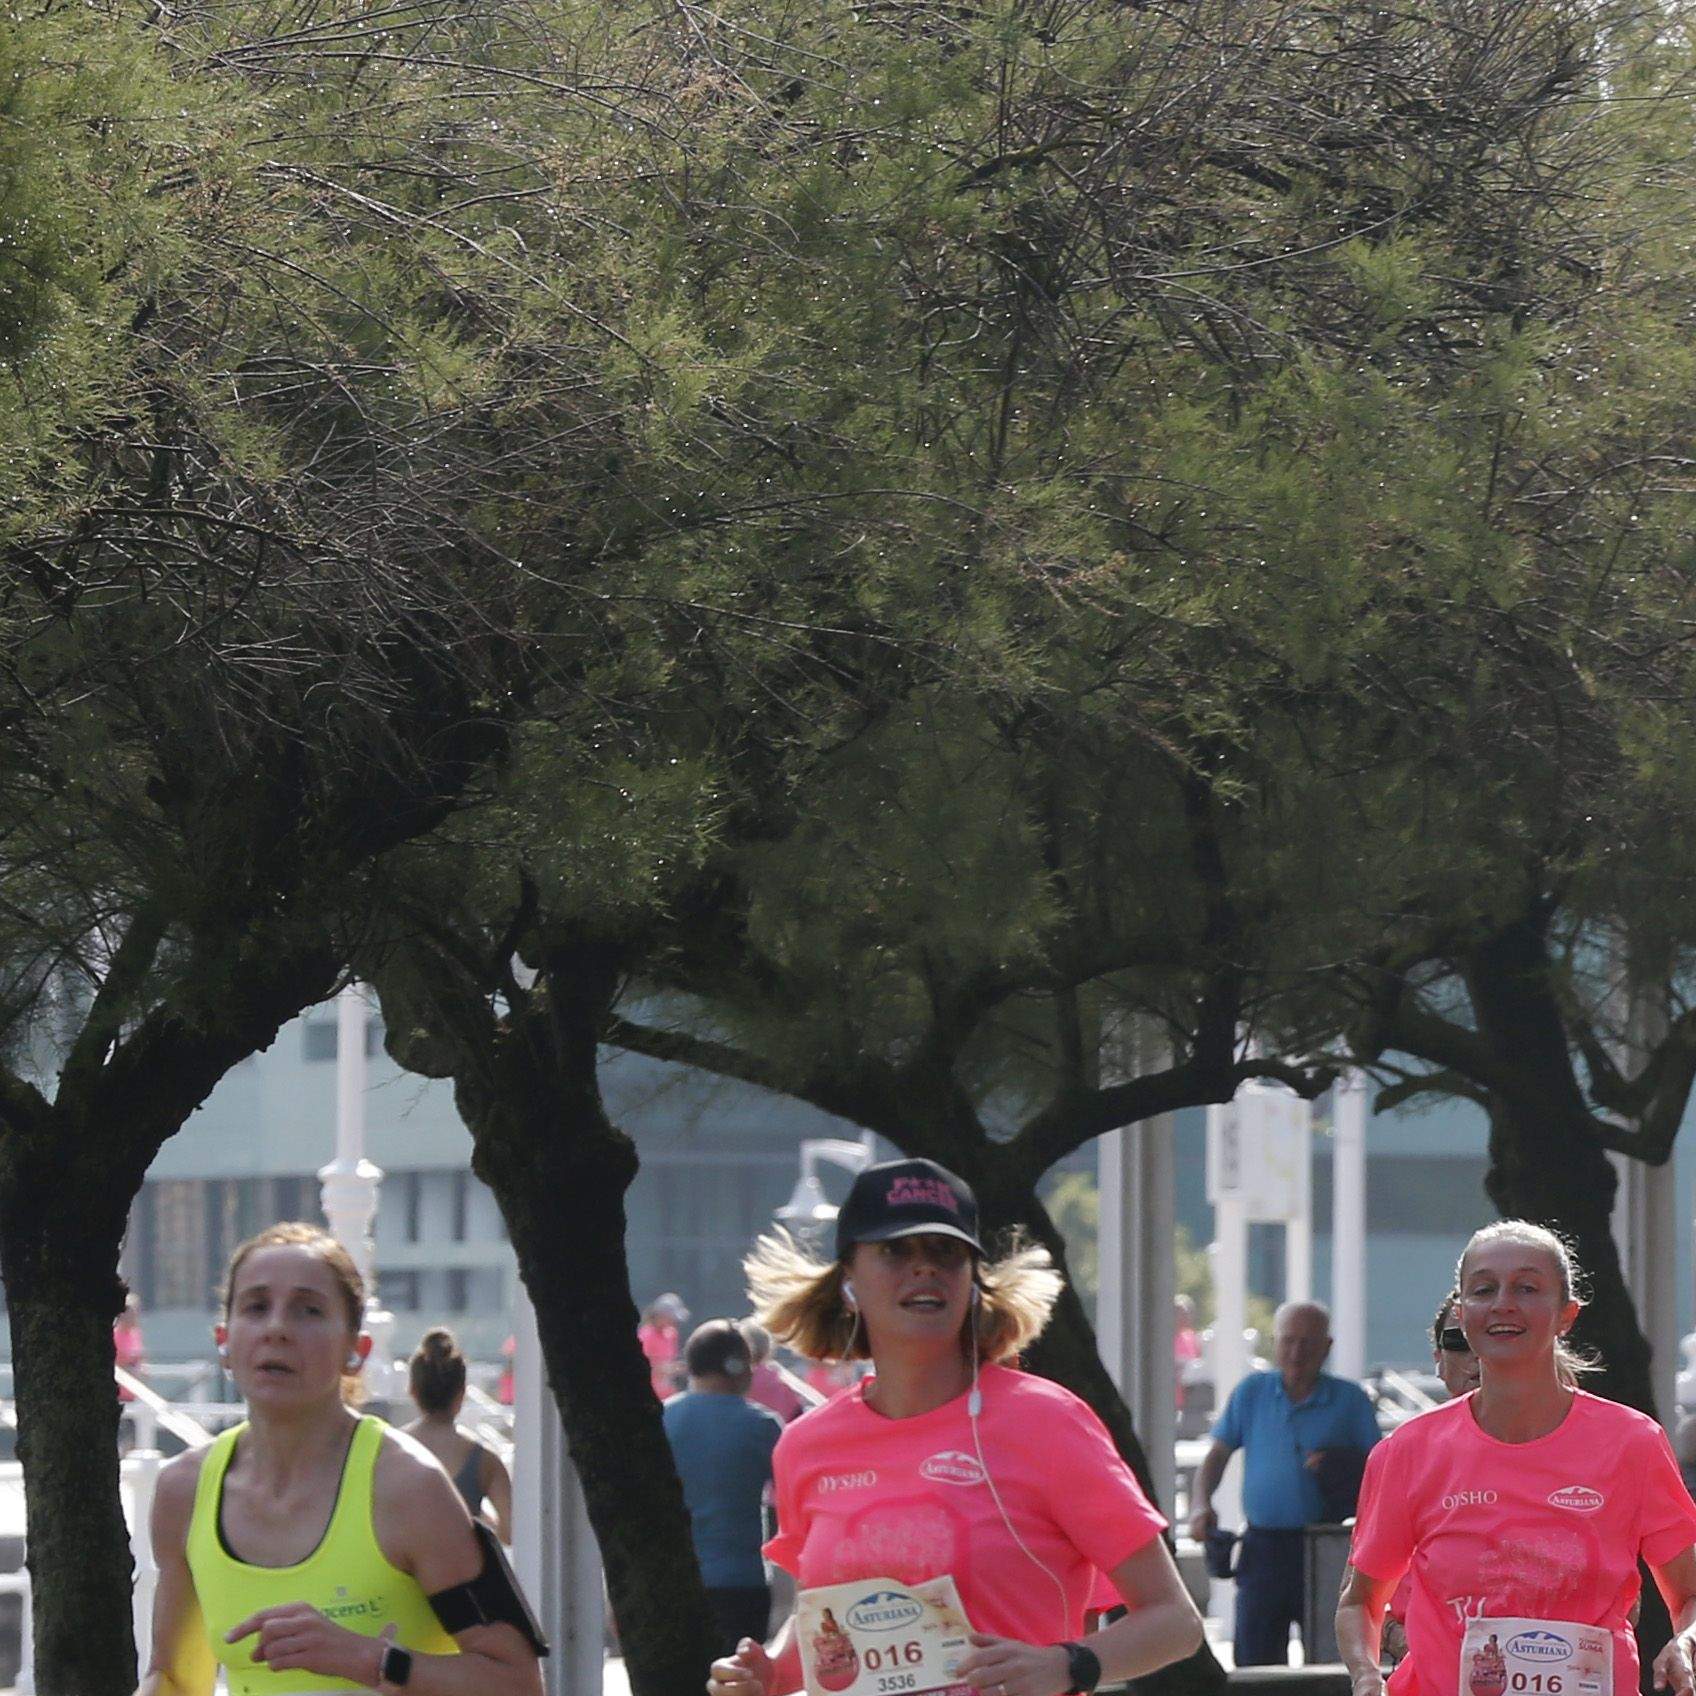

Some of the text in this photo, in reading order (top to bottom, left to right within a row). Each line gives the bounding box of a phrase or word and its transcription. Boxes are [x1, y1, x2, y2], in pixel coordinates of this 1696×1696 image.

[817, 1470, 877, 1494] OYSHO
[1442, 1489, 1498, 1510] OYSHO
[1552, 1495, 1600, 1507] ASTURIANA
[853, 1606, 919, 1625] ASTURIANA
[864, 1640, 924, 1671] 016
[1510, 1640, 1569, 1657] ASTURIANA
[878, 1674, 917, 1693] 3536
[1511, 1673, 1563, 1694] 016
